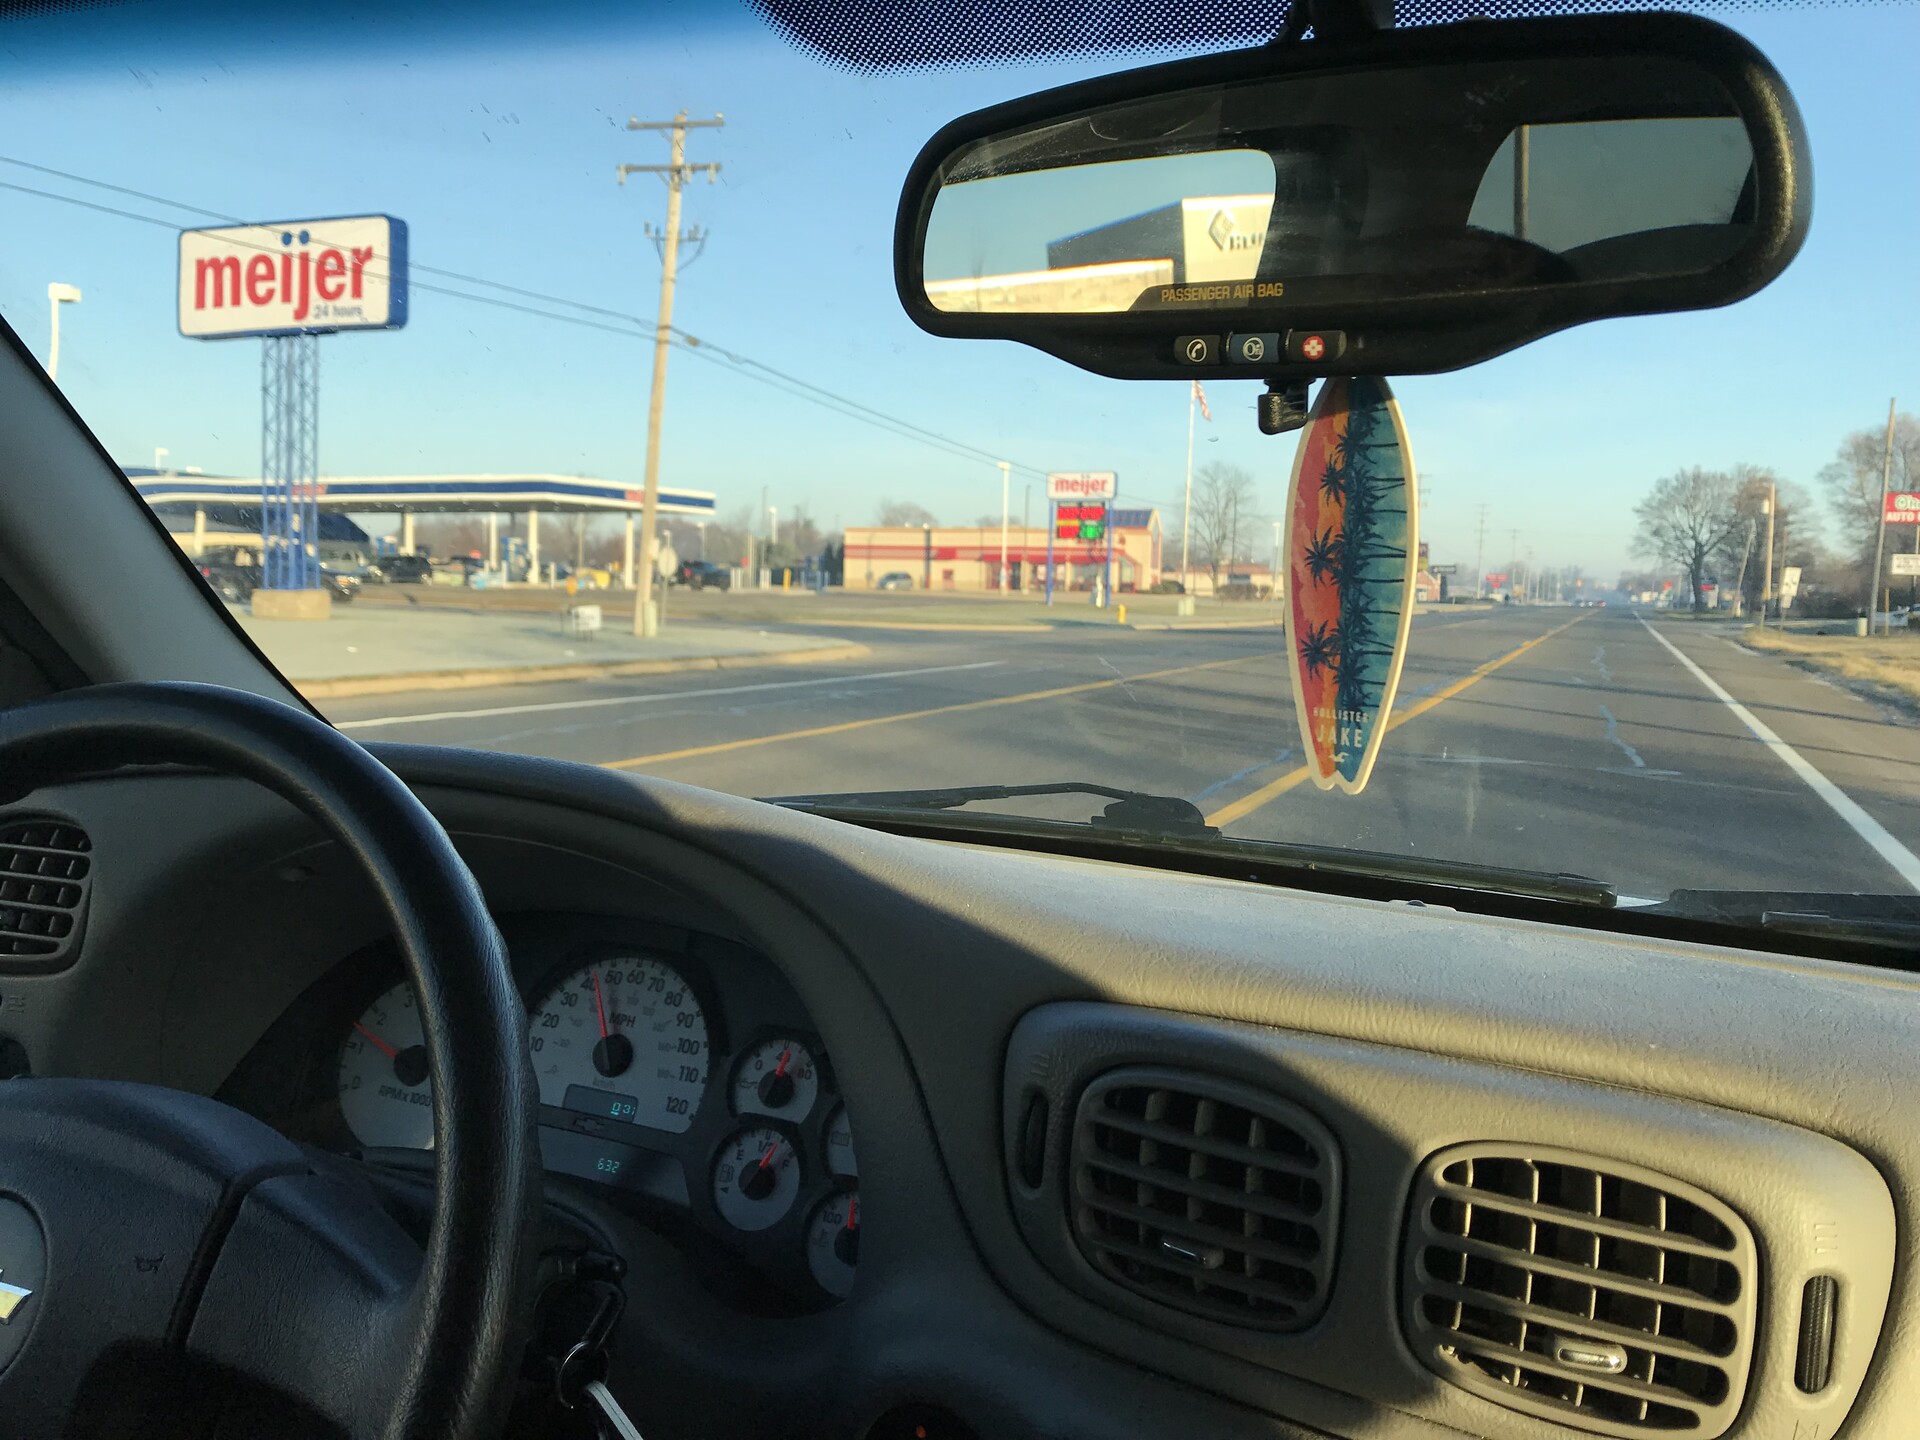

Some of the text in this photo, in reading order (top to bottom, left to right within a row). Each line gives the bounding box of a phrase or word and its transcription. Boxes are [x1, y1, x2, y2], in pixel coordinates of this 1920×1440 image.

[194, 230, 373, 320] meijer
[1161, 282, 1284, 303] PASSENGER AIR BAG
[314, 304, 363, 319] 24 hours
[1055, 473, 1108, 496] meijer
[1886, 511, 1915, 522] AUTO
[1313, 707, 1369, 723] HOLLISTER
[1317, 724, 1363, 748] JAKE
[605, 970, 623, 985] 50
[627, 969, 645, 985] 60
[648, 976, 665, 993] 70
[560, 991, 578, 1007] 30
[664, 991, 683, 1007] 80
[377, 1012, 387, 1025] 2
[542, 1012, 560, 1028] 20
[609, 1011, 636, 1028] MPH
[676, 1011, 694, 1028] 90
[531, 1036, 544, 1052] 10
[678, 1037, 700, 1055] 100
[679, 1065, 699, 1083] 110
[798, 1068, 812, 1080] 80
[666, 1096, 689, 1115] 120
